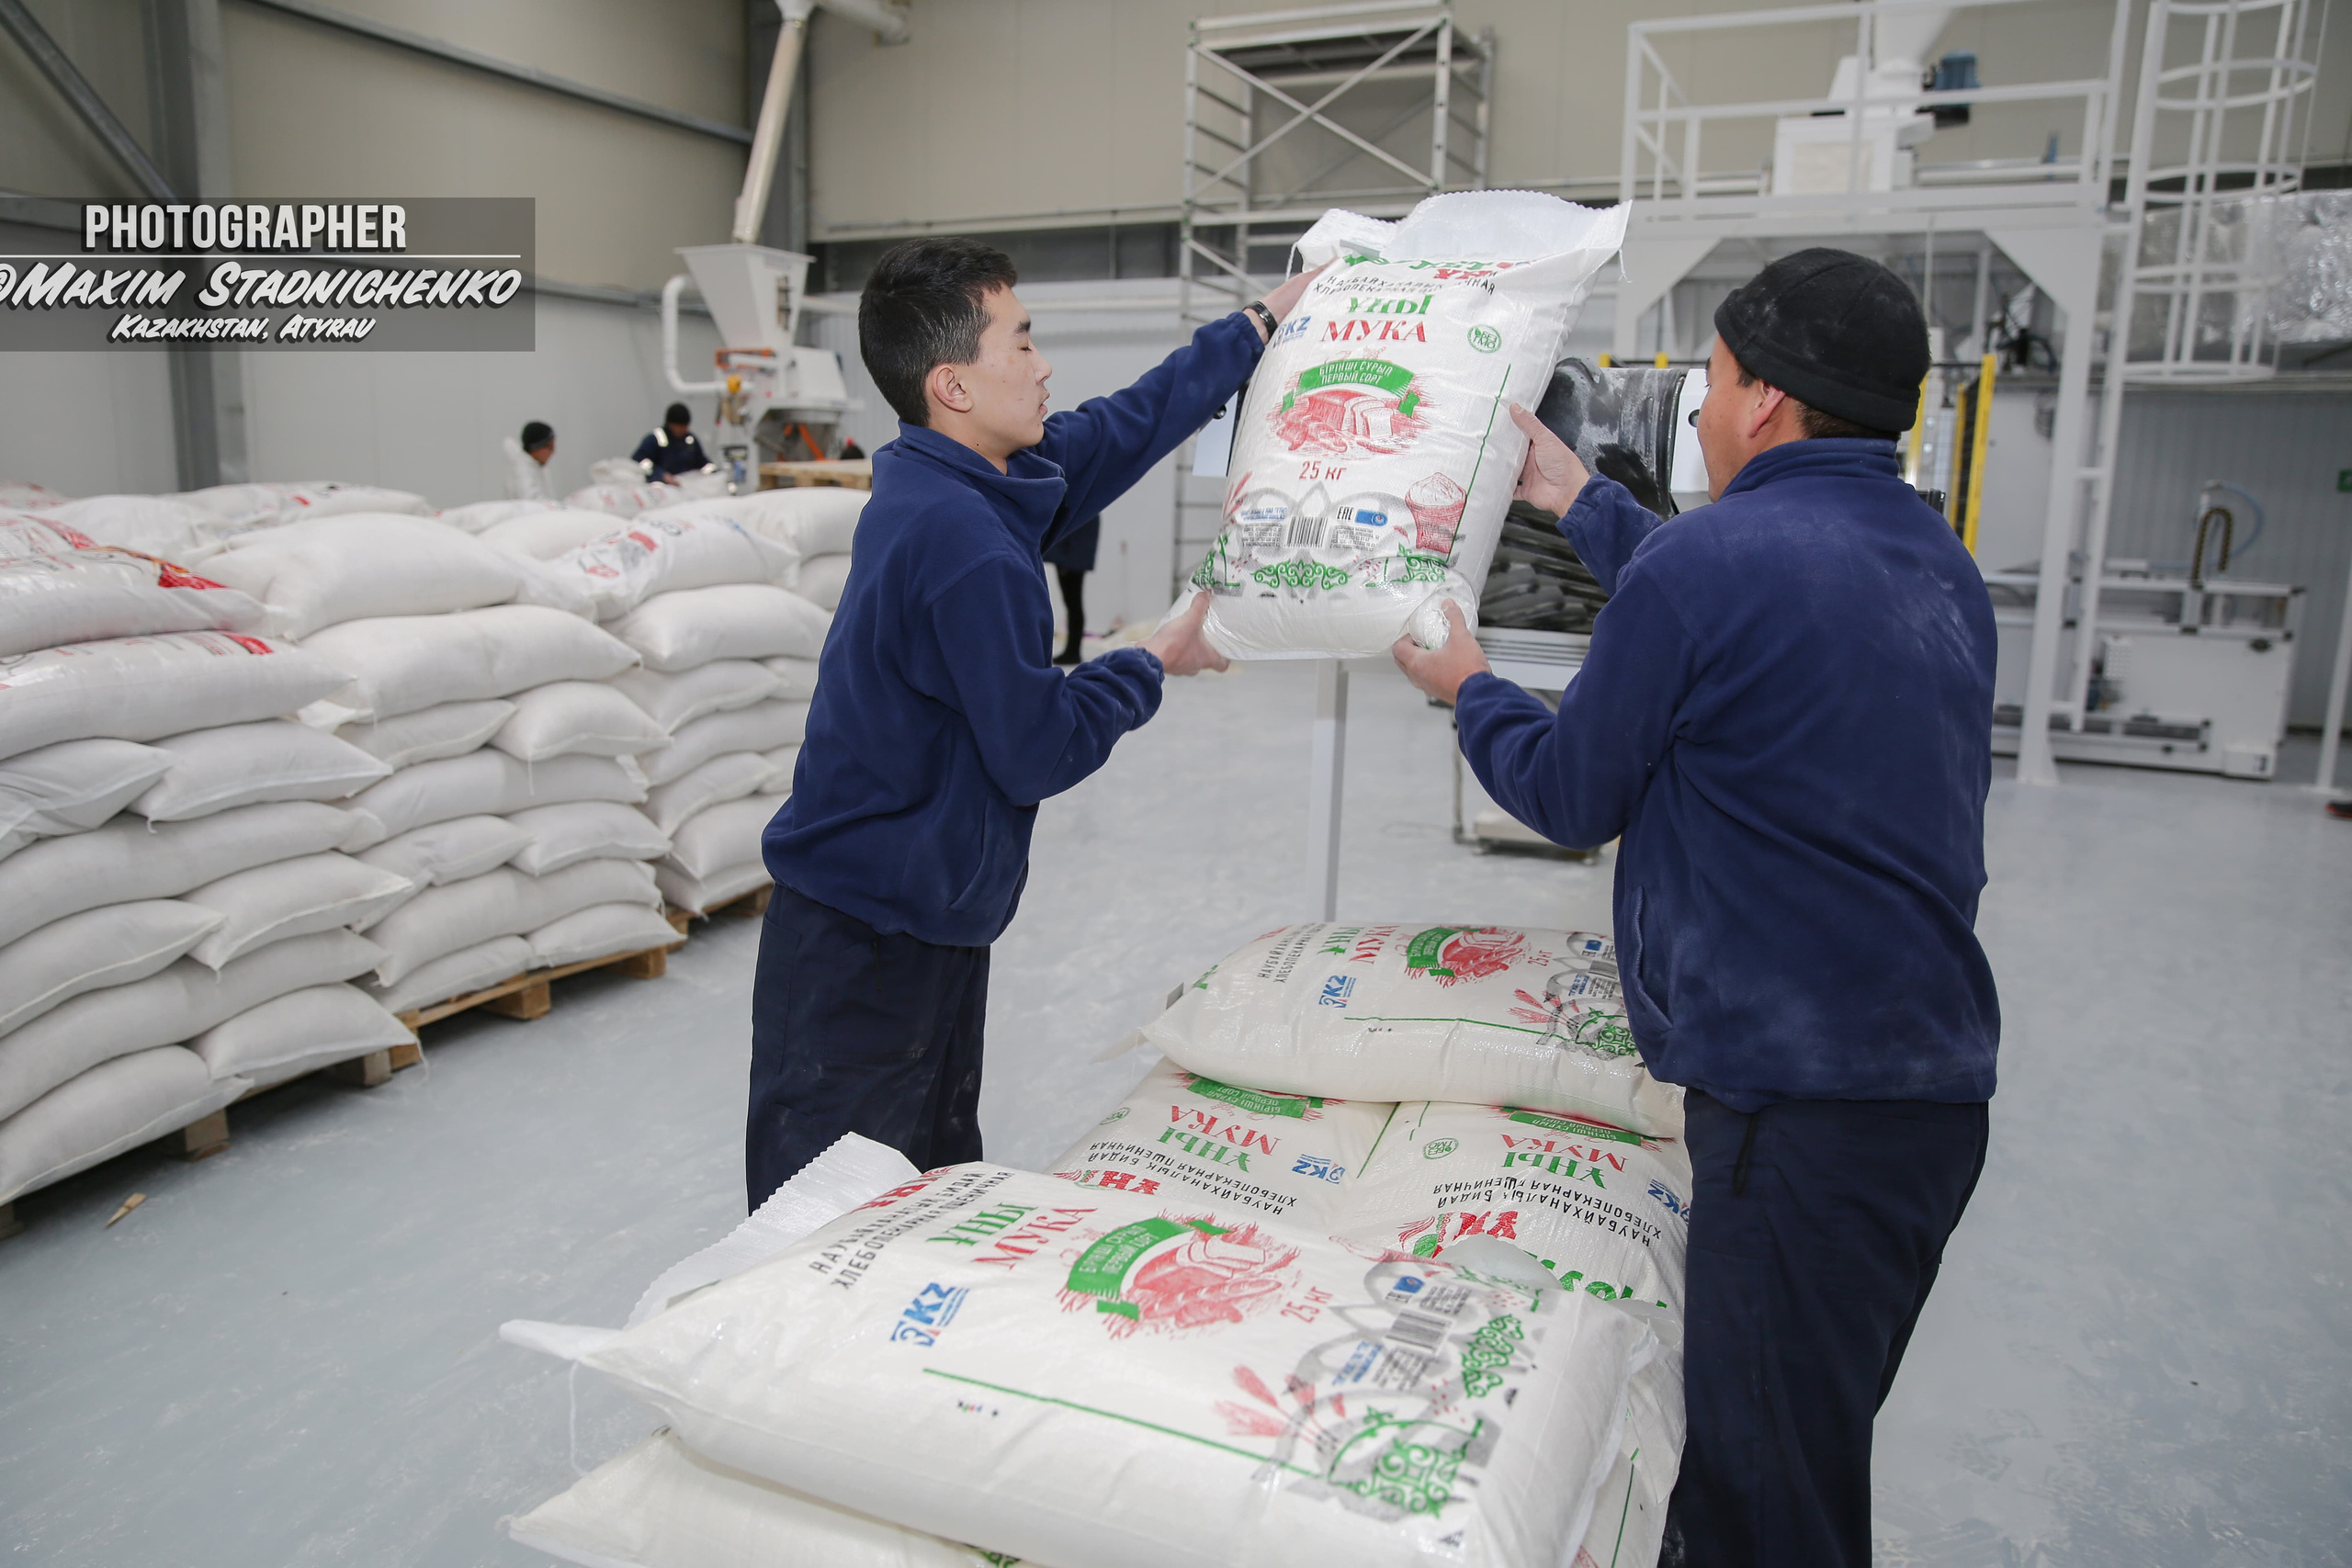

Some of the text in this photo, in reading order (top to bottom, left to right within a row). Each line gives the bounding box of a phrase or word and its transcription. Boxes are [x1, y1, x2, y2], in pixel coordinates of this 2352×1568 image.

[1320, 320, 1428, 344] МУКА
[1473, 335, 1496, 349] ГМО
[1321, 370, 1383, 385] ПЕРВЫЙ СОРТ
[1298, 460, 1321, 479] 25
[1349, 925, 1400, 964] МУКА
[1528, 956, 1549, 966] 25
[1216, 1086, 1279, 1106] ПЕРВЫЙ СОРТ
[1171, 1105, 1283, 1156] МУКА
[1088, 1151, 1140, 1166] БИДАЙ
[1499, 1134, 1629, 1173] МУКА
[1090, 1141, 1298, 1208] ХЛЕБОПЕКАРНАЯ ПШЕНИЧНАЯ
[1437, 1190, 1493, 1209] БИДАЙ
[1531, 1179, 1662, 1239] ХЛЕБОПЕКАРНАЯ
[1503, 1190, 1650, 1247] НАУБАЙХАНАЛЫ
[971, 1207, 1099, 1270] МУКА
[1281, 1301, 1320, 1324] 25
